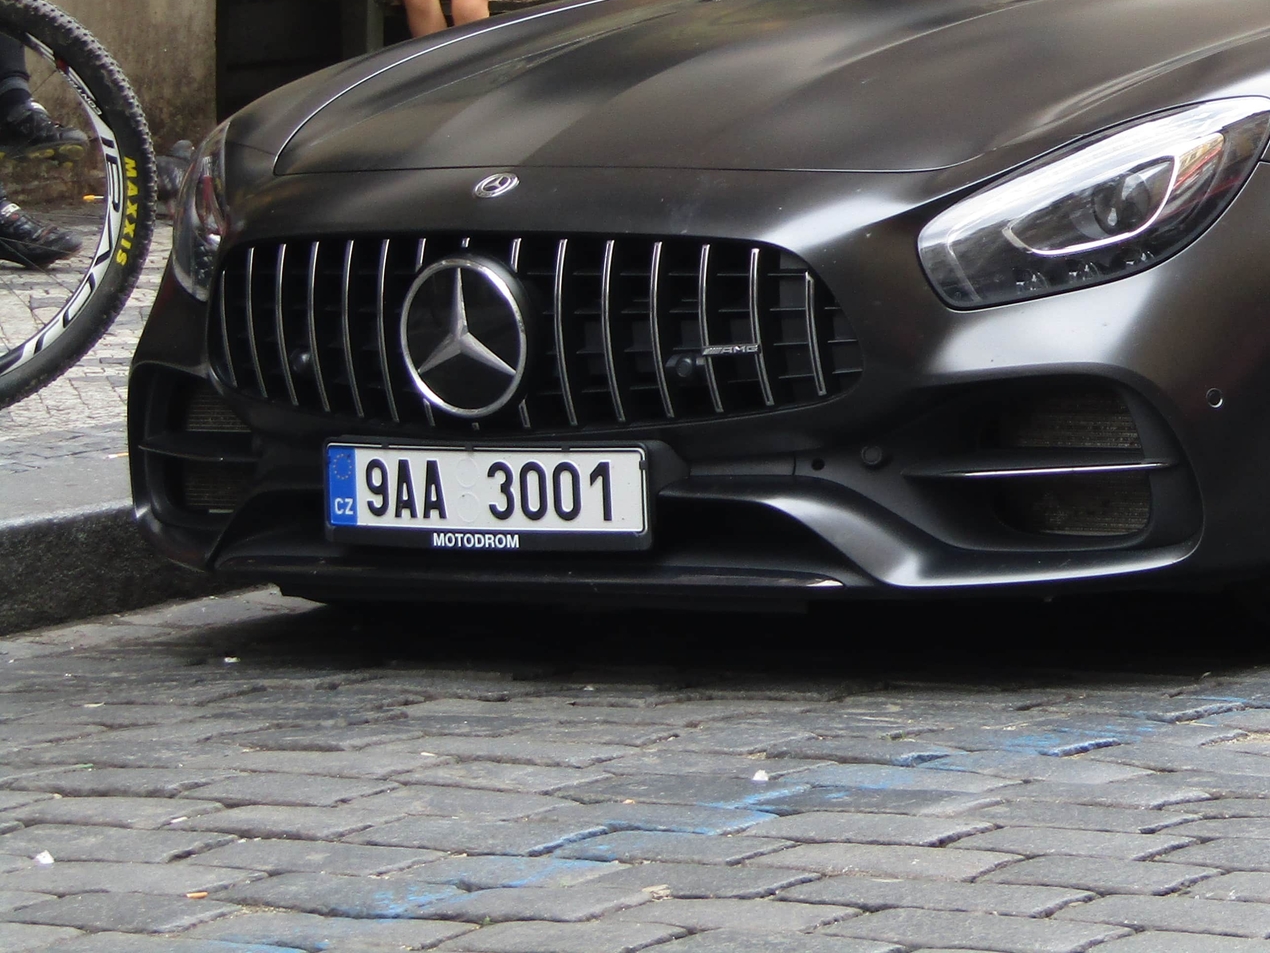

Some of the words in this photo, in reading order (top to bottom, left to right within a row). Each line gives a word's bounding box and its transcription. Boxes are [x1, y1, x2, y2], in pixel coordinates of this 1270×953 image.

[115, 155, 139, 268] MAXXIS
[334, 497, 355, 516] CZ
[365, 458, 448, 520] 9AA
[486, 460, 614, 522] 3001
[433, 532, 520, 549] MOTODROM
